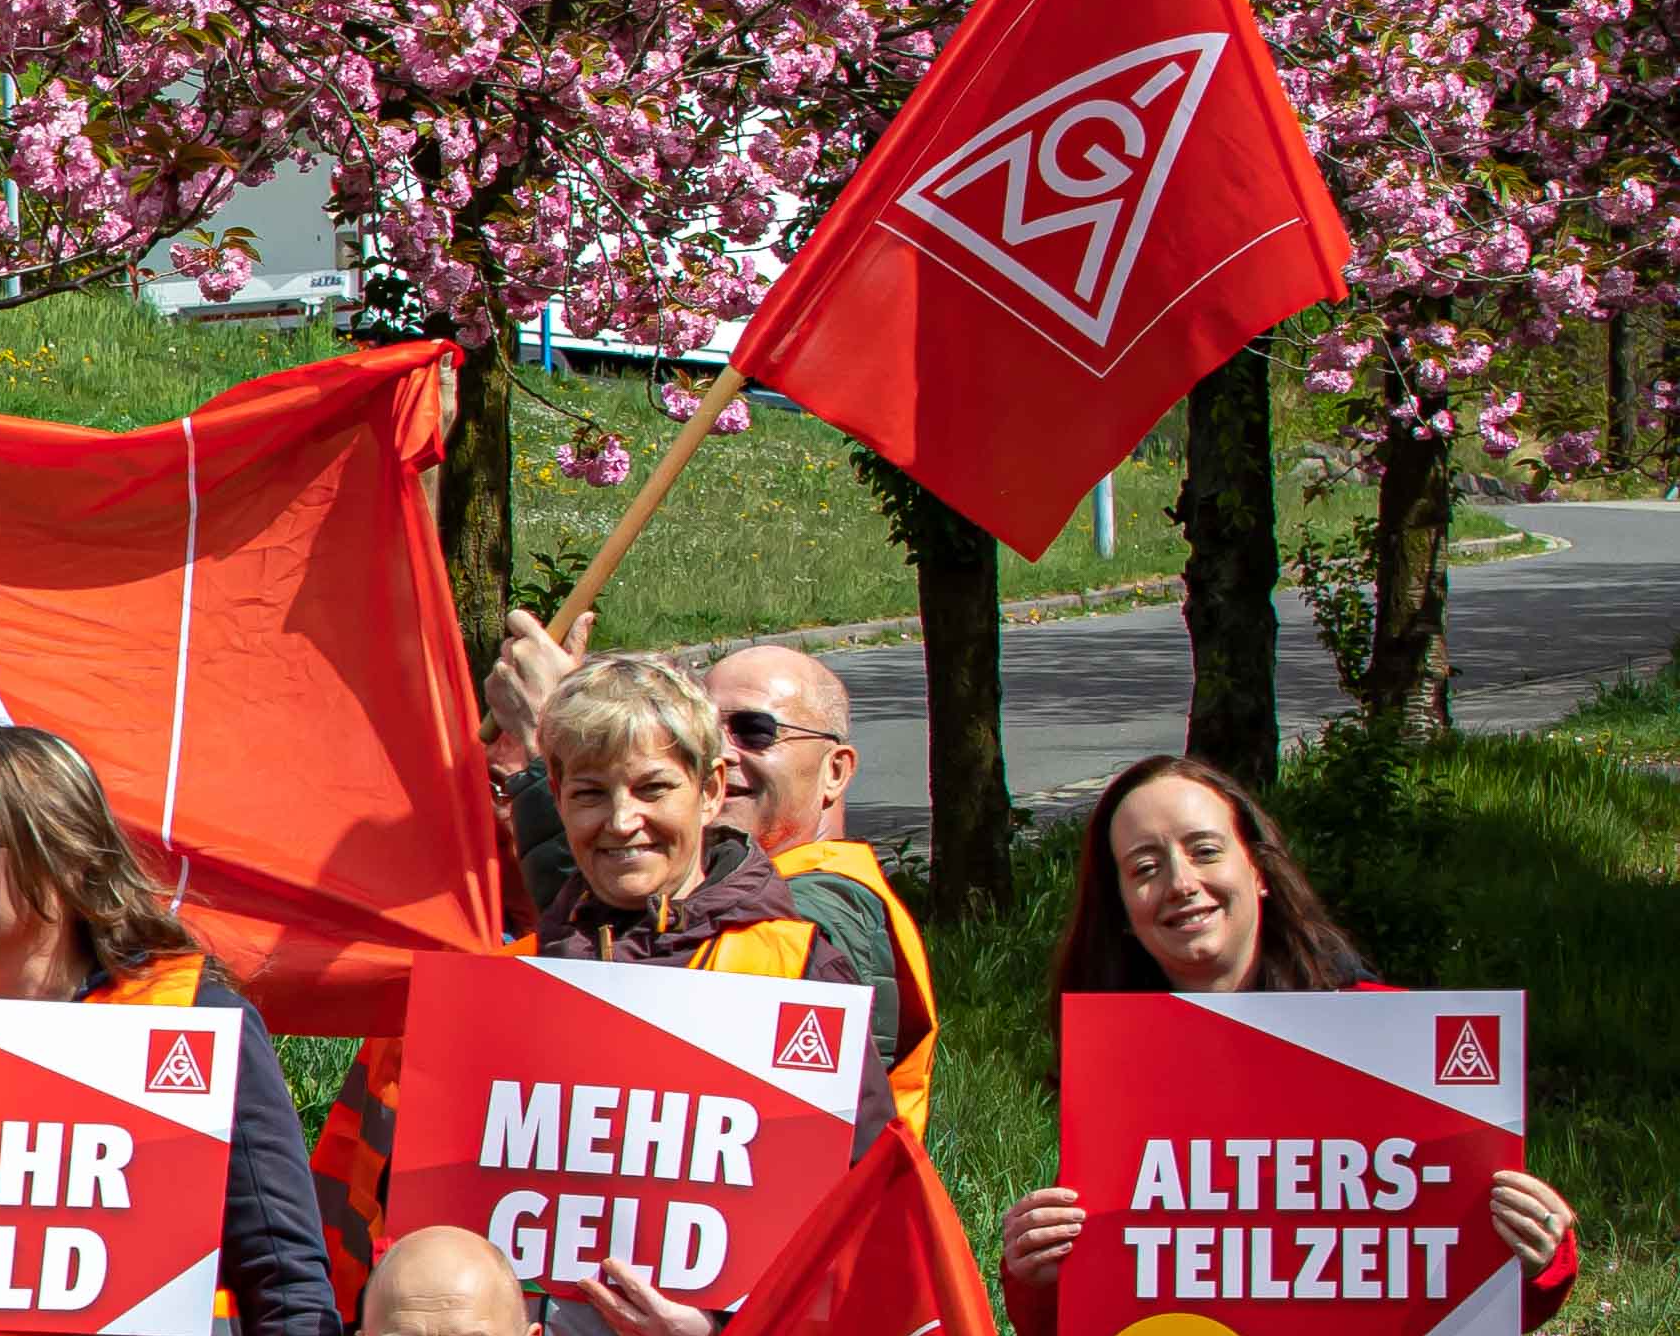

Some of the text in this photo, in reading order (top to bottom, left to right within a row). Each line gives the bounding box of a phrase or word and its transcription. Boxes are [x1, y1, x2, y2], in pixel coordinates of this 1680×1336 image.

[479, 1079, 759, 1187] MEHR
[1130, 1137, 1450, 1211] ALTERS-
[489, 1190, 729, 1291] GELD
[1124, 1227, 1459, 1299] TEILZEIT
